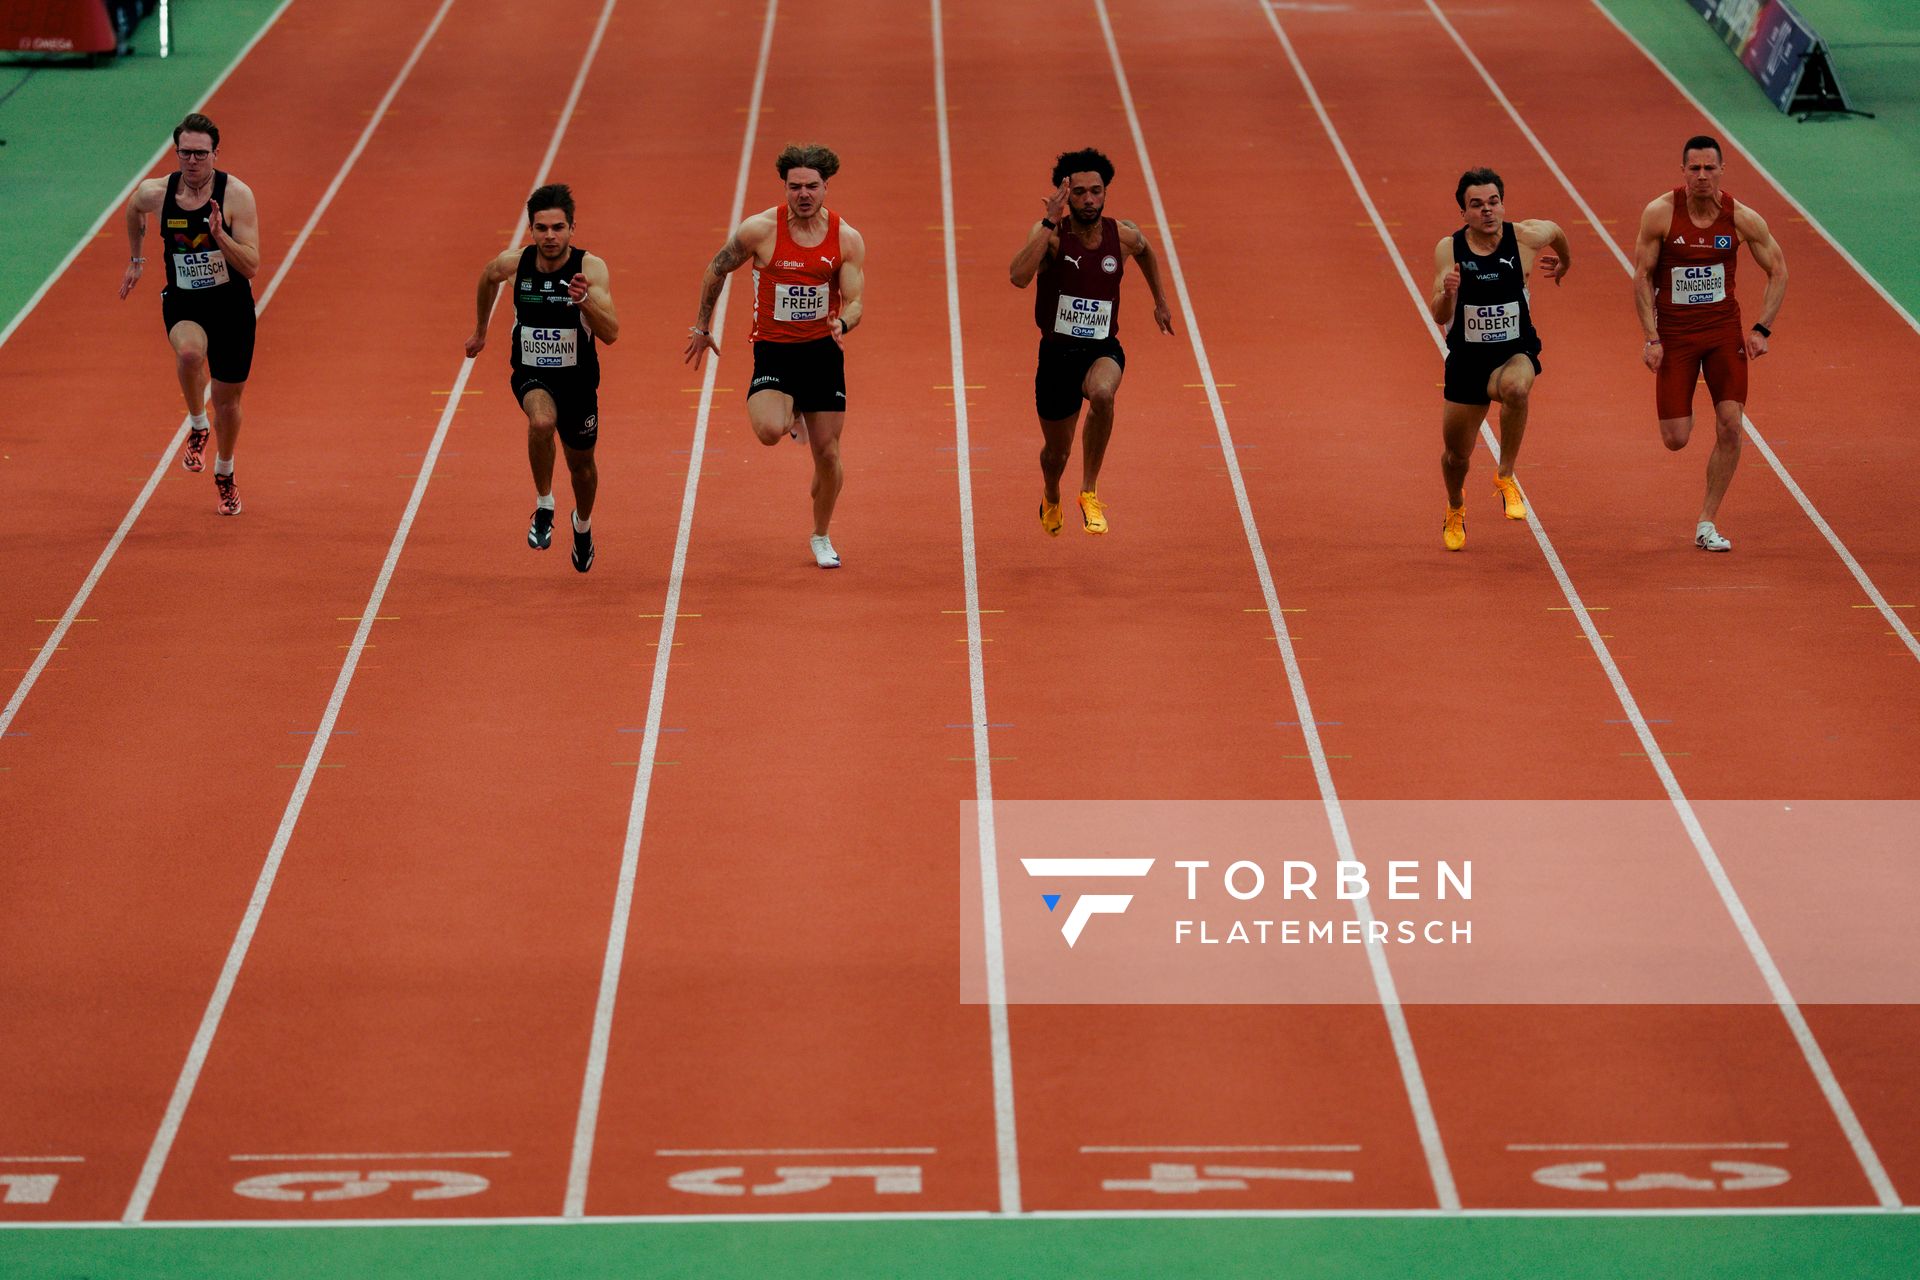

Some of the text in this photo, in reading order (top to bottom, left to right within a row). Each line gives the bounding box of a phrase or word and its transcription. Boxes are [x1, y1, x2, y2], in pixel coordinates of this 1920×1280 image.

[184, 253, 209, 265] GLS
[783, 260, 804, 268] Brillux
[178, 261, 224, 277] TRABITZSCH
[1685, 267, 1712, 279] GLS
[1676, 277, 1722, 291] STANGENBERG
[789, 286, 817, 297] GLS
[782, 297, 823, 309] FREHE
[1072, 299, 1100, 312] GLS
[1060, 309, 1108, 326] HARTMANN
[1477, 305, 1505, 317] GLS
[1468, 315, 1517, 330] OLBERT
[533, 330, 561, 341] GLS
[523, 340, 574, 354] GUSSMANN
[667, 1165, 922, 1196] 5
[1102, 1163, 1354, 1193] 4
[1532, 1161, 1791, 1191] 3
[233, 1169, 490, 1201] 6
